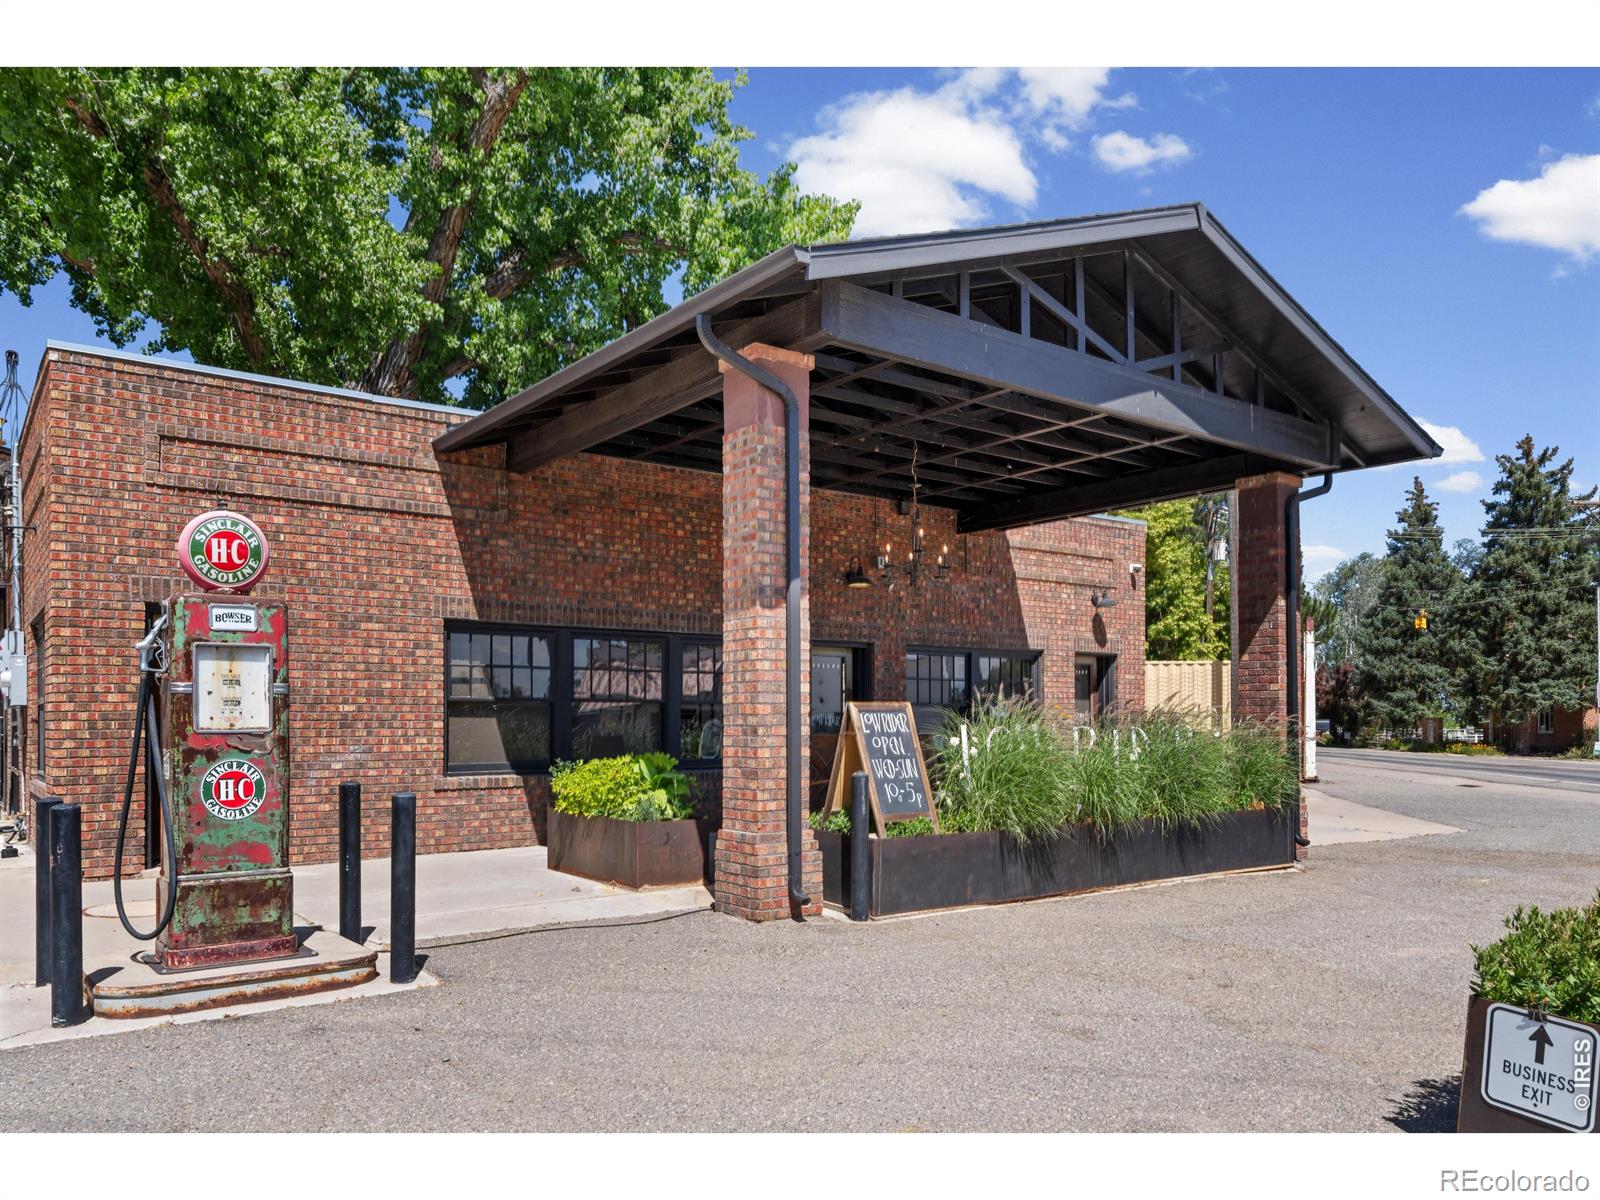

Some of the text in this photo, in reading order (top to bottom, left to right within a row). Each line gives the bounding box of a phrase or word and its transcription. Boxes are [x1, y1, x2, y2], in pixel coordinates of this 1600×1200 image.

[195, 520, 258, 548] SINCLAIR
[194, 555, 259, 582] GASOLINE
[215, 612, 252, 623] BOWSER
[860, 712, 910, 733] LOWRIDER
[872, 736, 906, 755] OPEN
[206, 761, 260, 783] SINCLAIR
[872, 759, 919, 779] WED-SUN
[206, 797, 261, 819] GASOLINE
[1503, 1059, 1576, 1094] BUSINESS
[1522, 1084, 1553, 1105] EXIT
